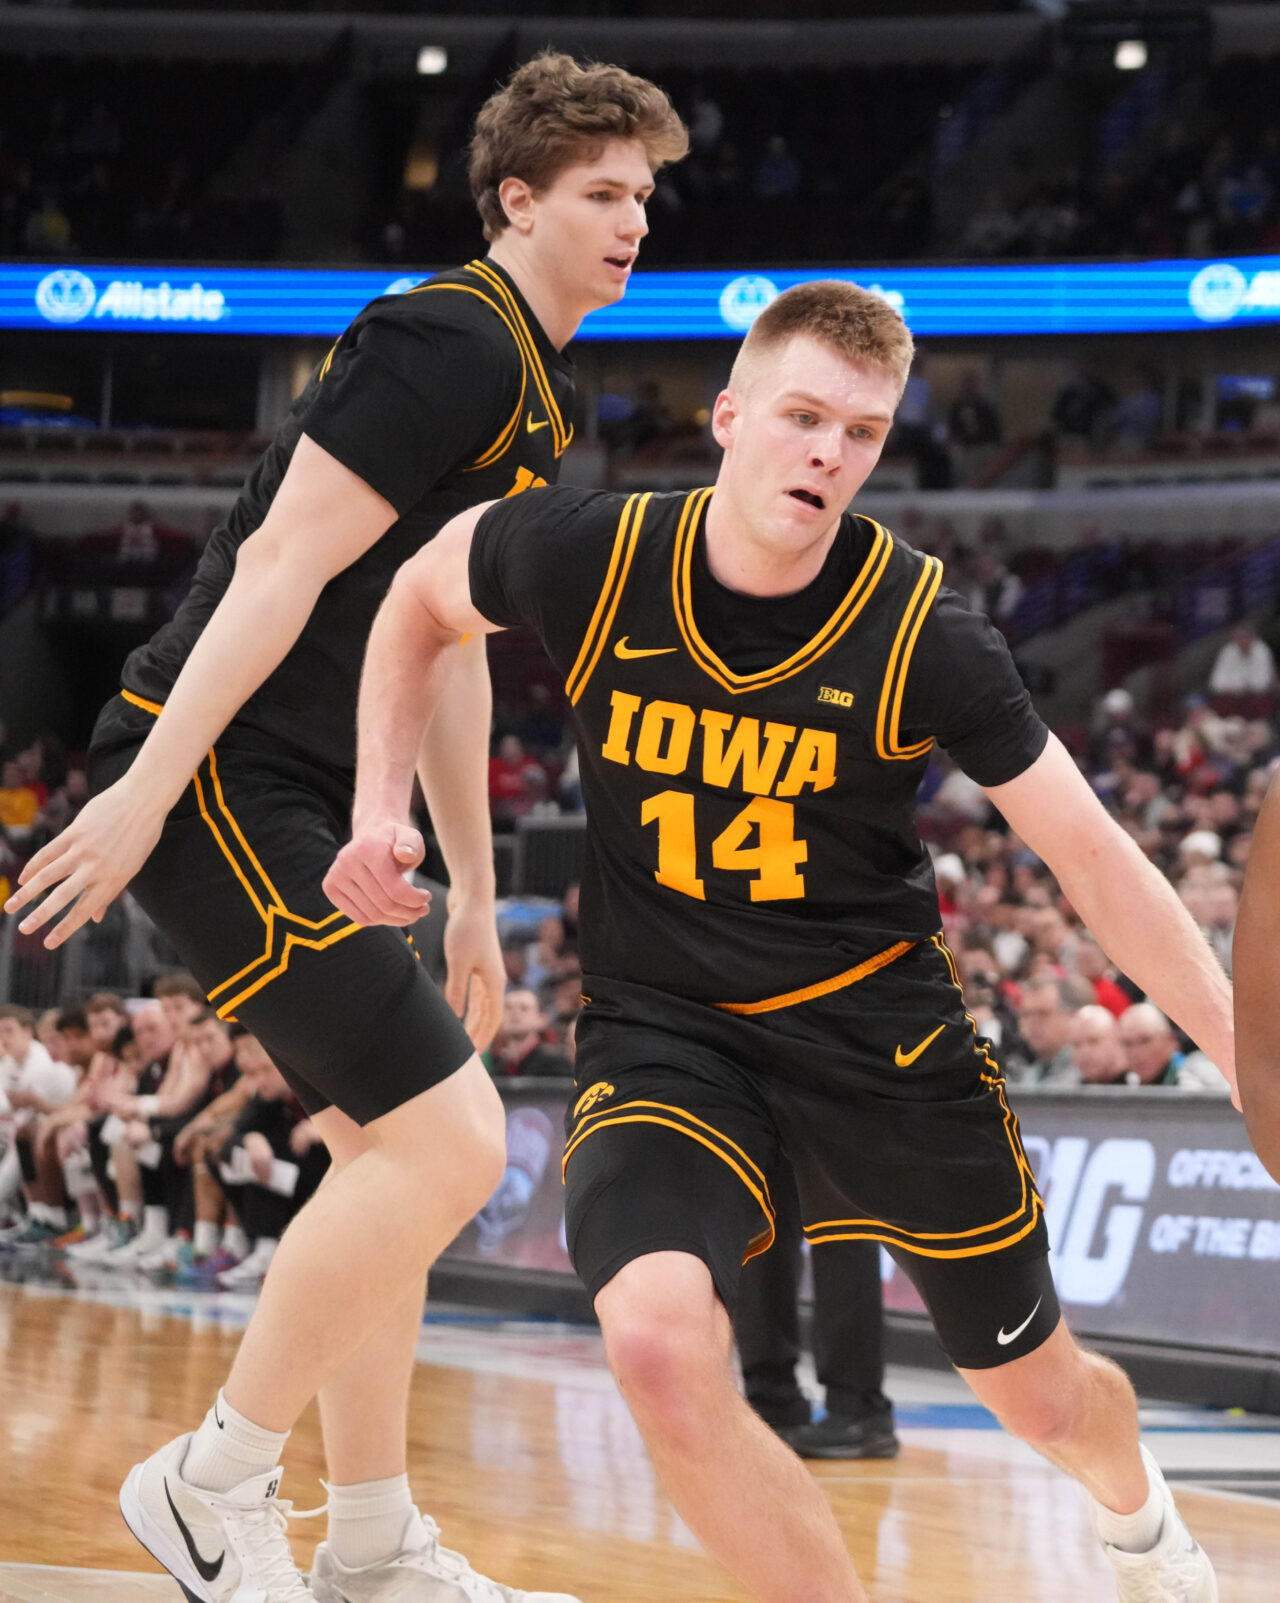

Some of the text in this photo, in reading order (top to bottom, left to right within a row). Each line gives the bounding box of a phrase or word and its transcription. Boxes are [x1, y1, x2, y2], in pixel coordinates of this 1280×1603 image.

[94, 281, 225, 321] Allstate
[602, 690, 837, 796] IOWA
[641, 790, 808, 902] 14
[1149, 1214, 1194, 1253] OF
[1194, 1216, 1252, 1259] THE
